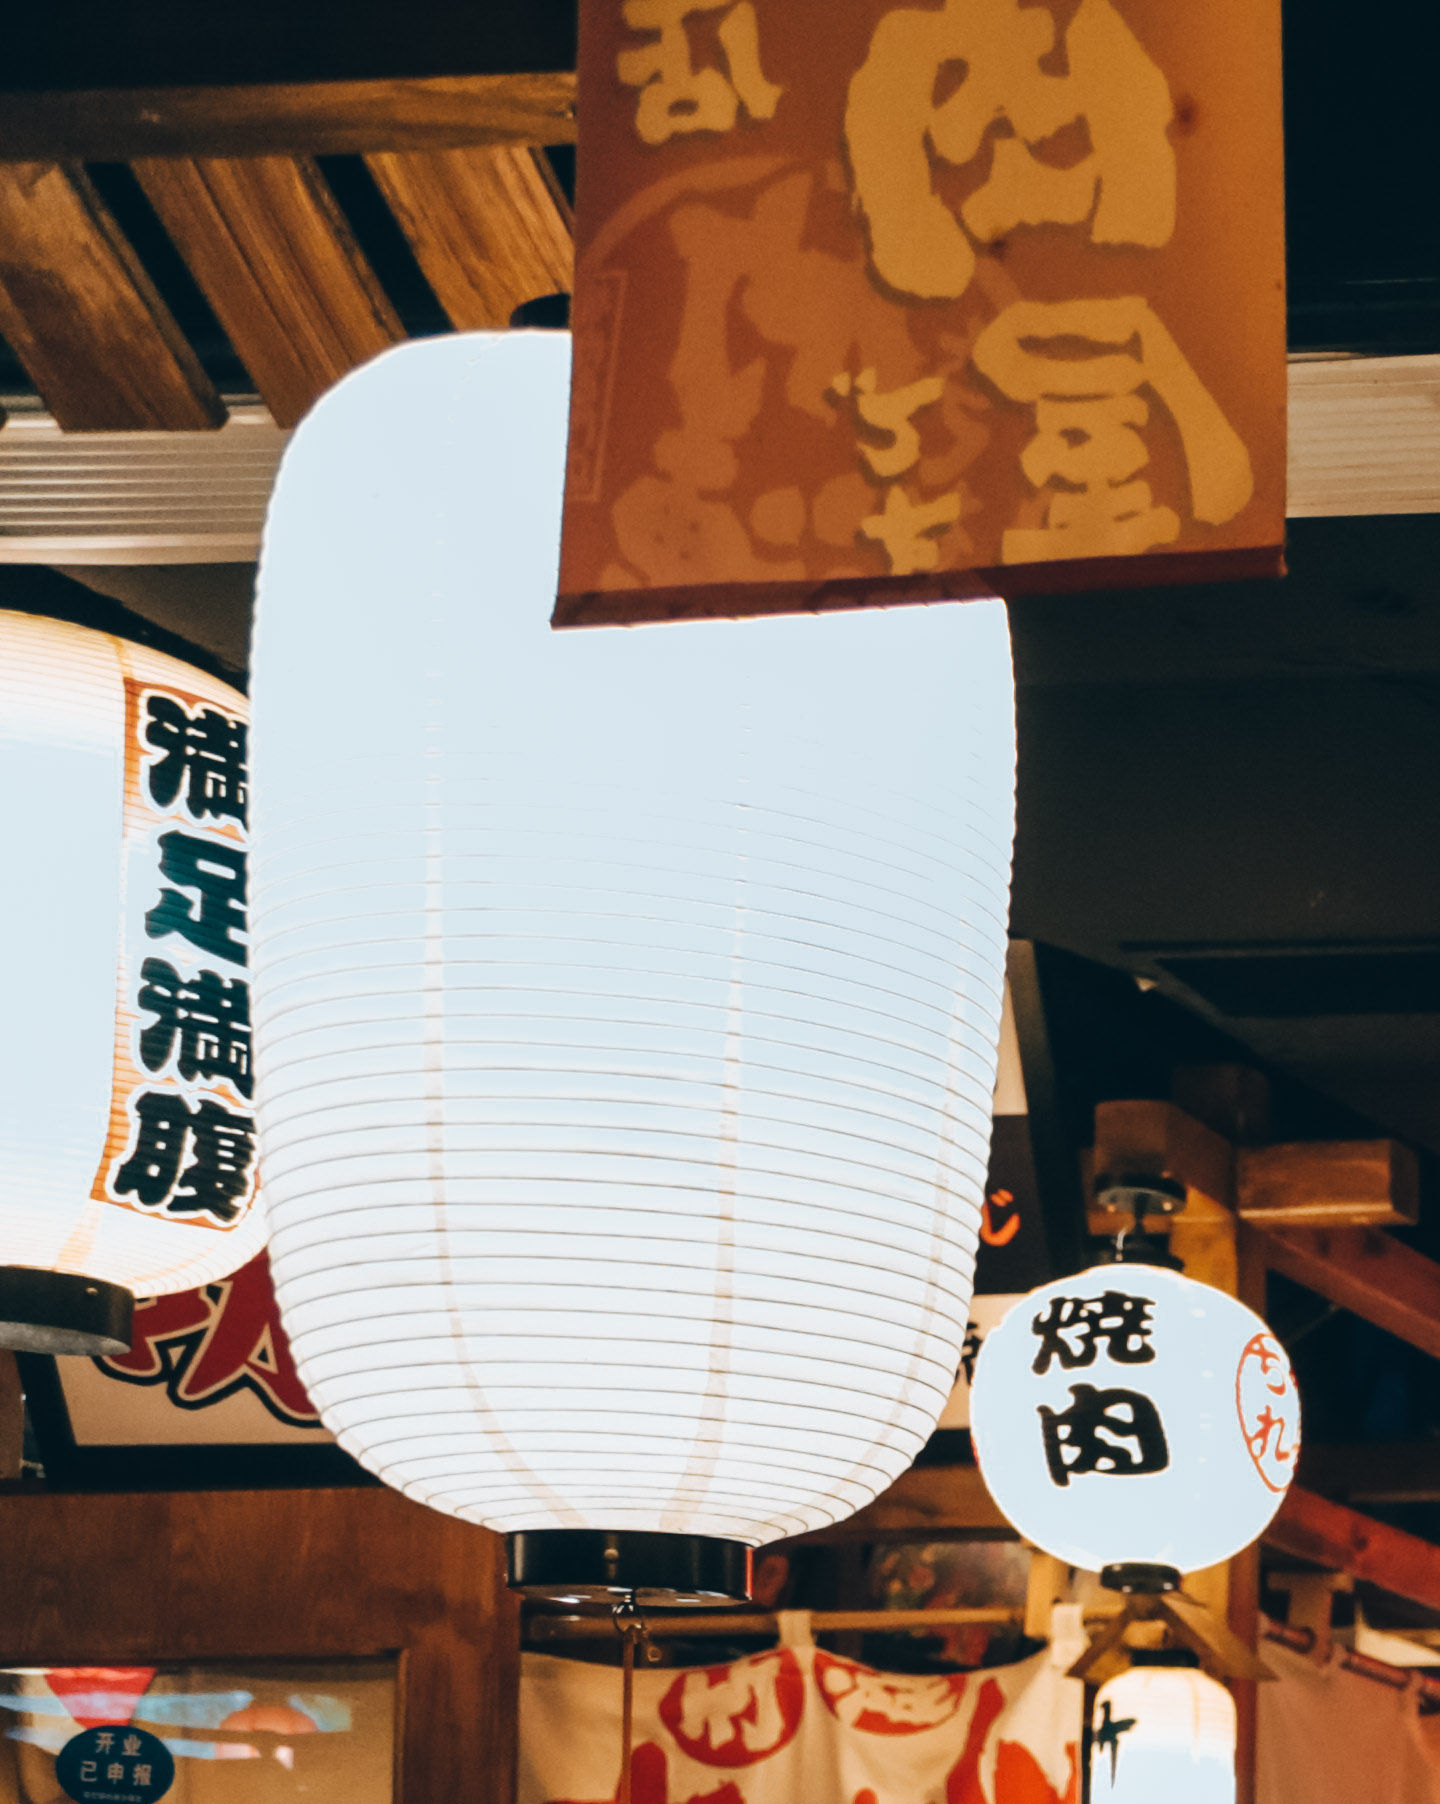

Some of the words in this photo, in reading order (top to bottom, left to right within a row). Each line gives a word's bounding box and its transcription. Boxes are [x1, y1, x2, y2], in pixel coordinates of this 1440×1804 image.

[112, 694, 257, 1226] 満足満腹
[1030, 1289, 1170, 1488] 焼肉
[95, 1731, 143, 1757] 开业
